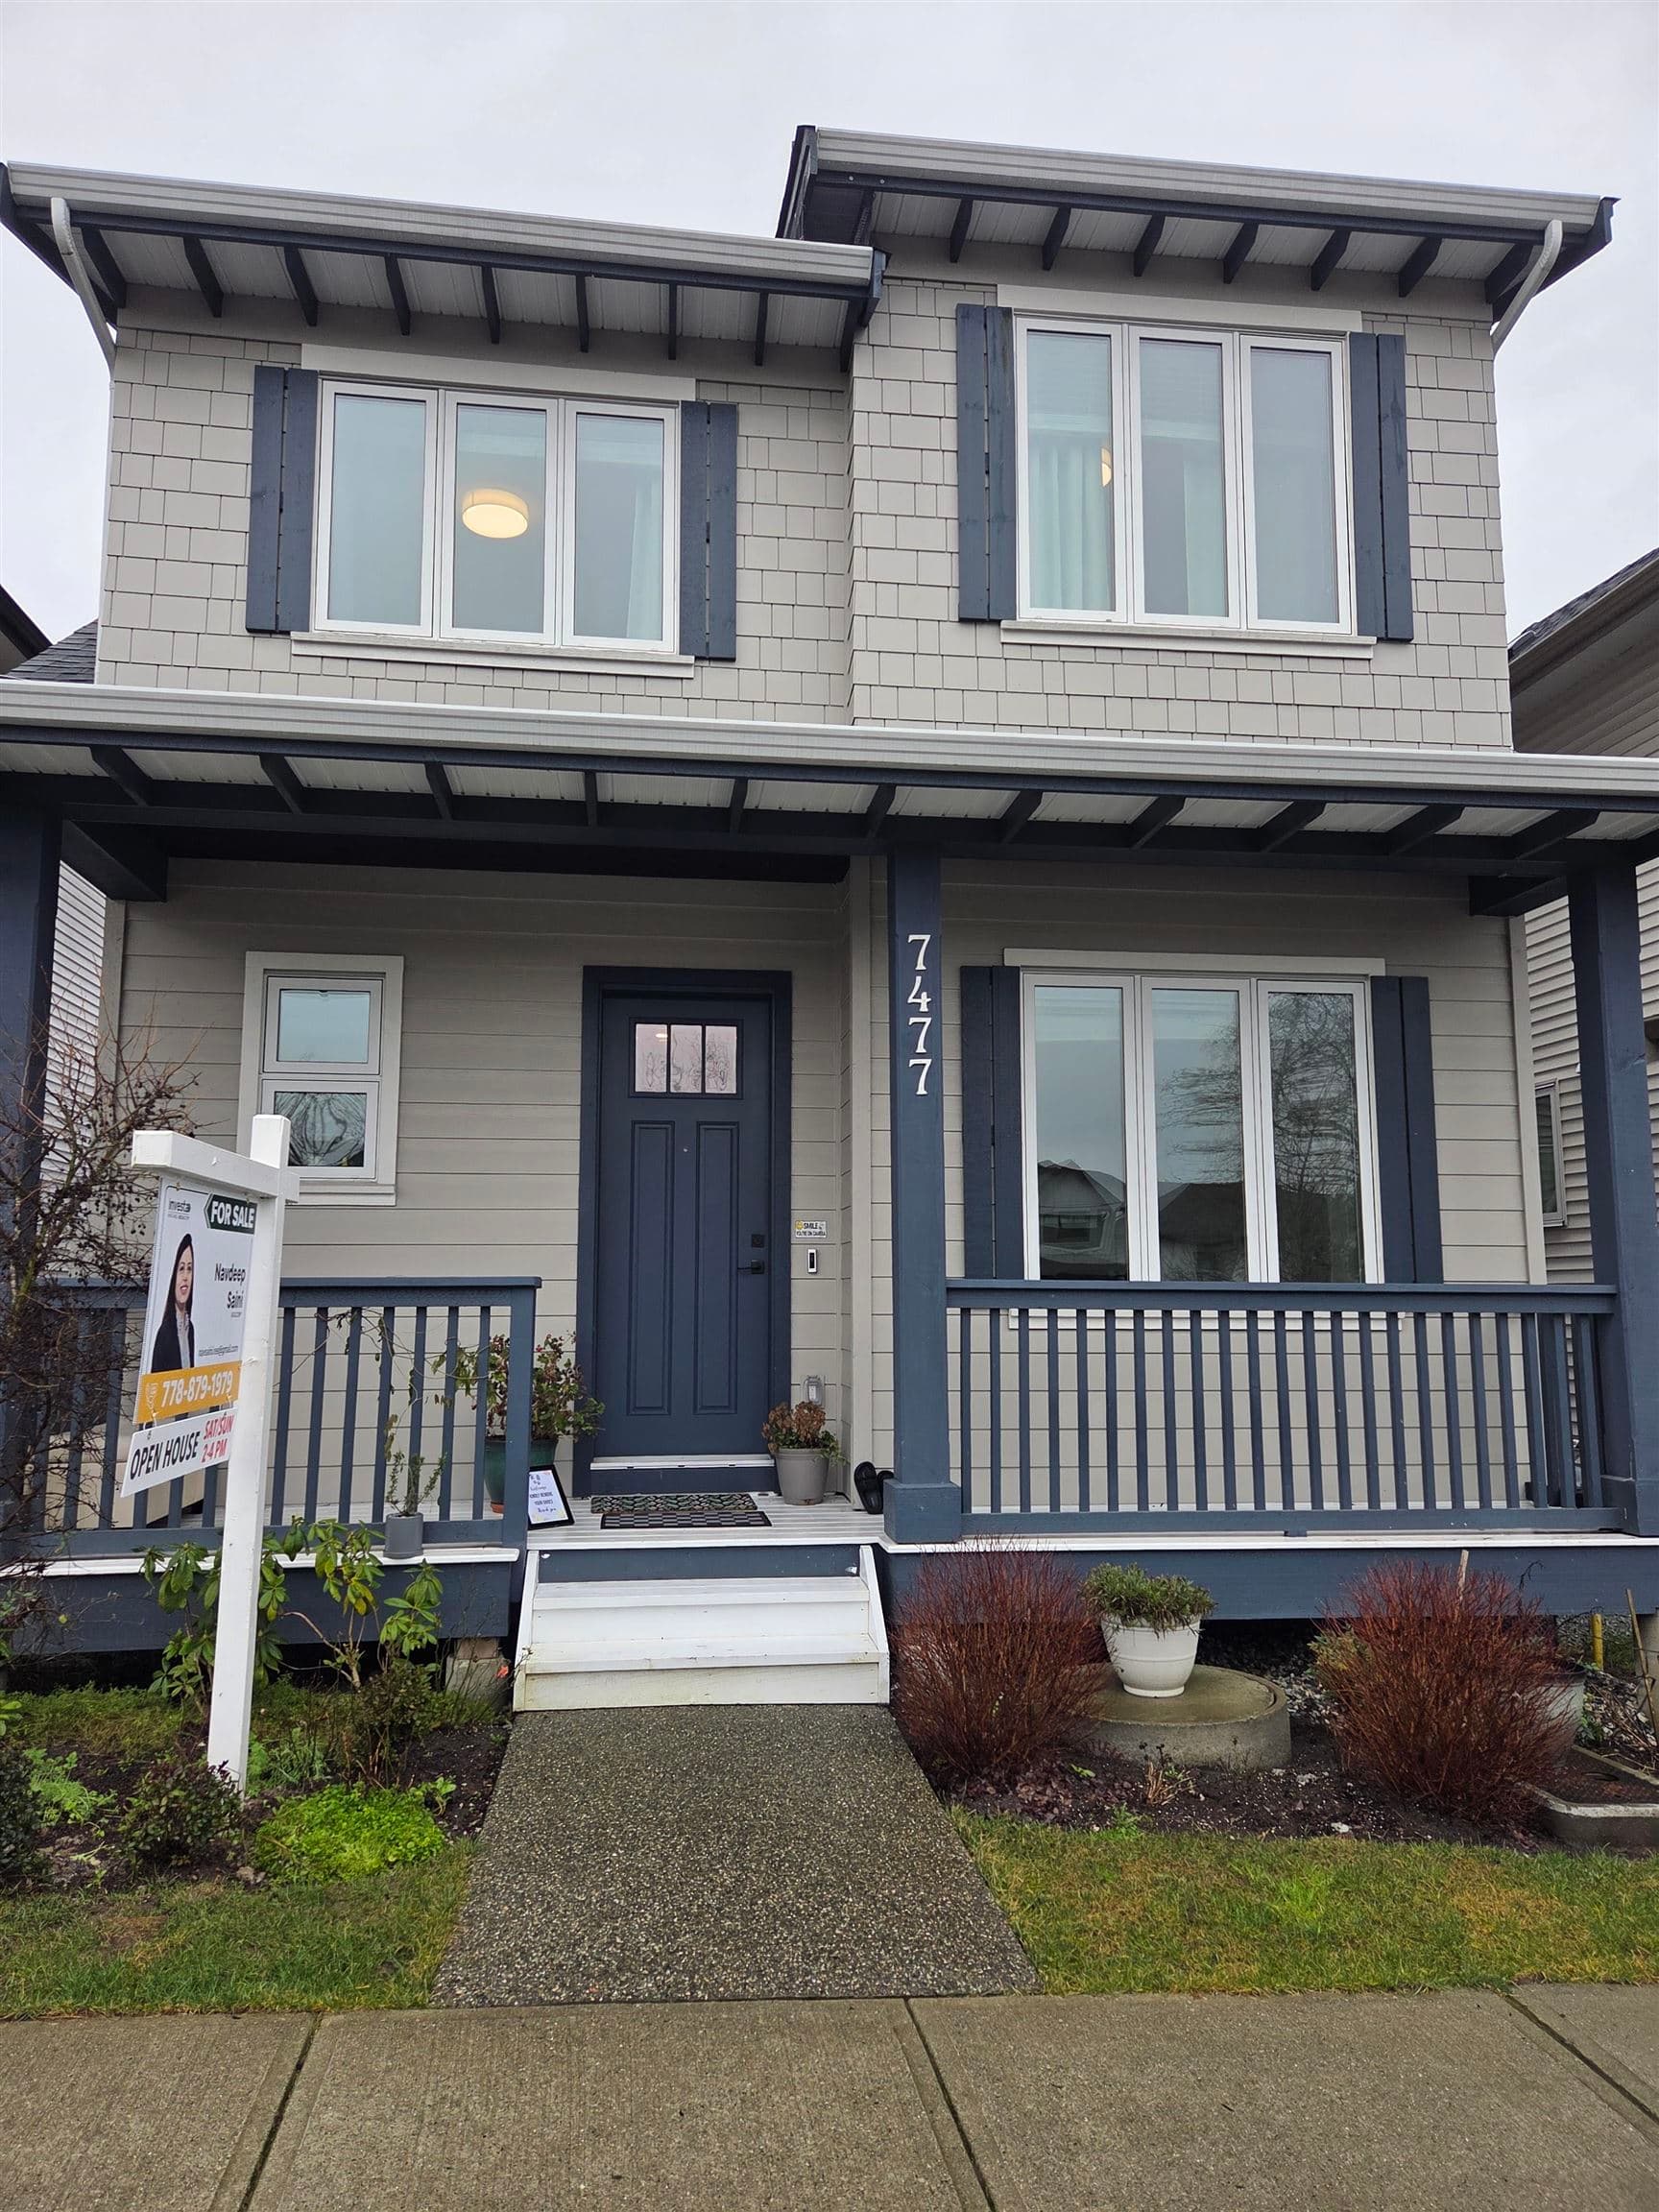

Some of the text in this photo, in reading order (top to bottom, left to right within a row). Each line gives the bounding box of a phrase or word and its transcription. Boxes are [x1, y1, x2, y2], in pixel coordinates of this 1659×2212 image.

[907, 934, 932, 1095] 7477
[210, 1200, 255, 1229] FOR SALE
[214, 1262, 246, 1286] Navdeep
[161, 1370, 233, 1407] 778-879-1979
[204, 1414, 234, 1440] SAT/SUN
[130, 1431, 201, 1479] OPEN HOUSE
[214, 1438, 228, 1457] PM
